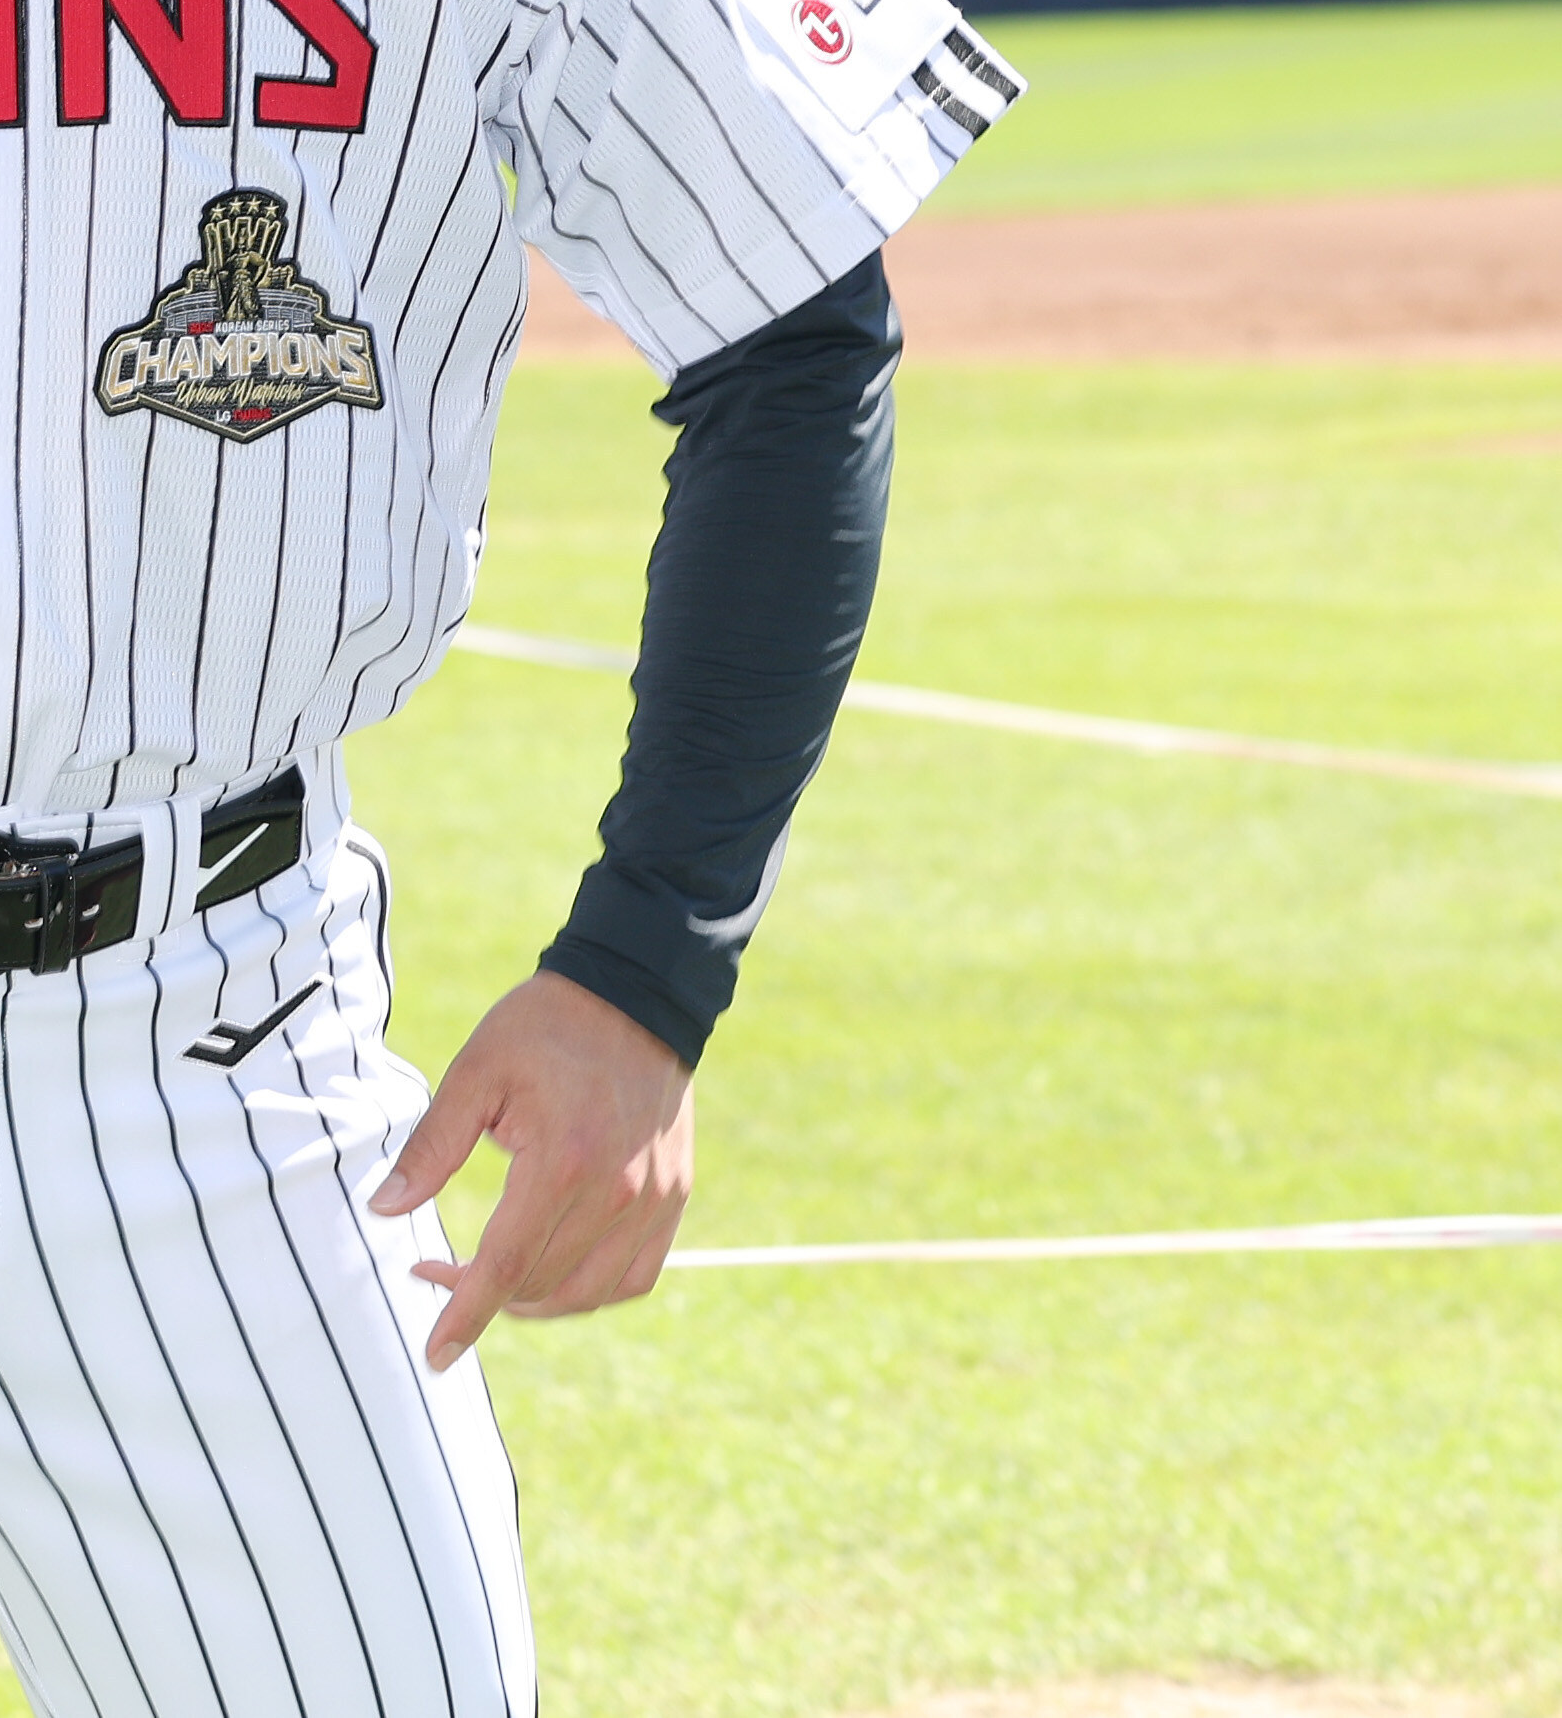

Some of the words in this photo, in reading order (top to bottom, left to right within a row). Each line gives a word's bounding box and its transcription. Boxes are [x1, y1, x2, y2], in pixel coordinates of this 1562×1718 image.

[215, 320, 254, 333] KOREAN
[256, 319, 291, 332] SERIES
[104, 328, 373, 400] CHAMPIONS
[215, 409, 232, 423] LG
